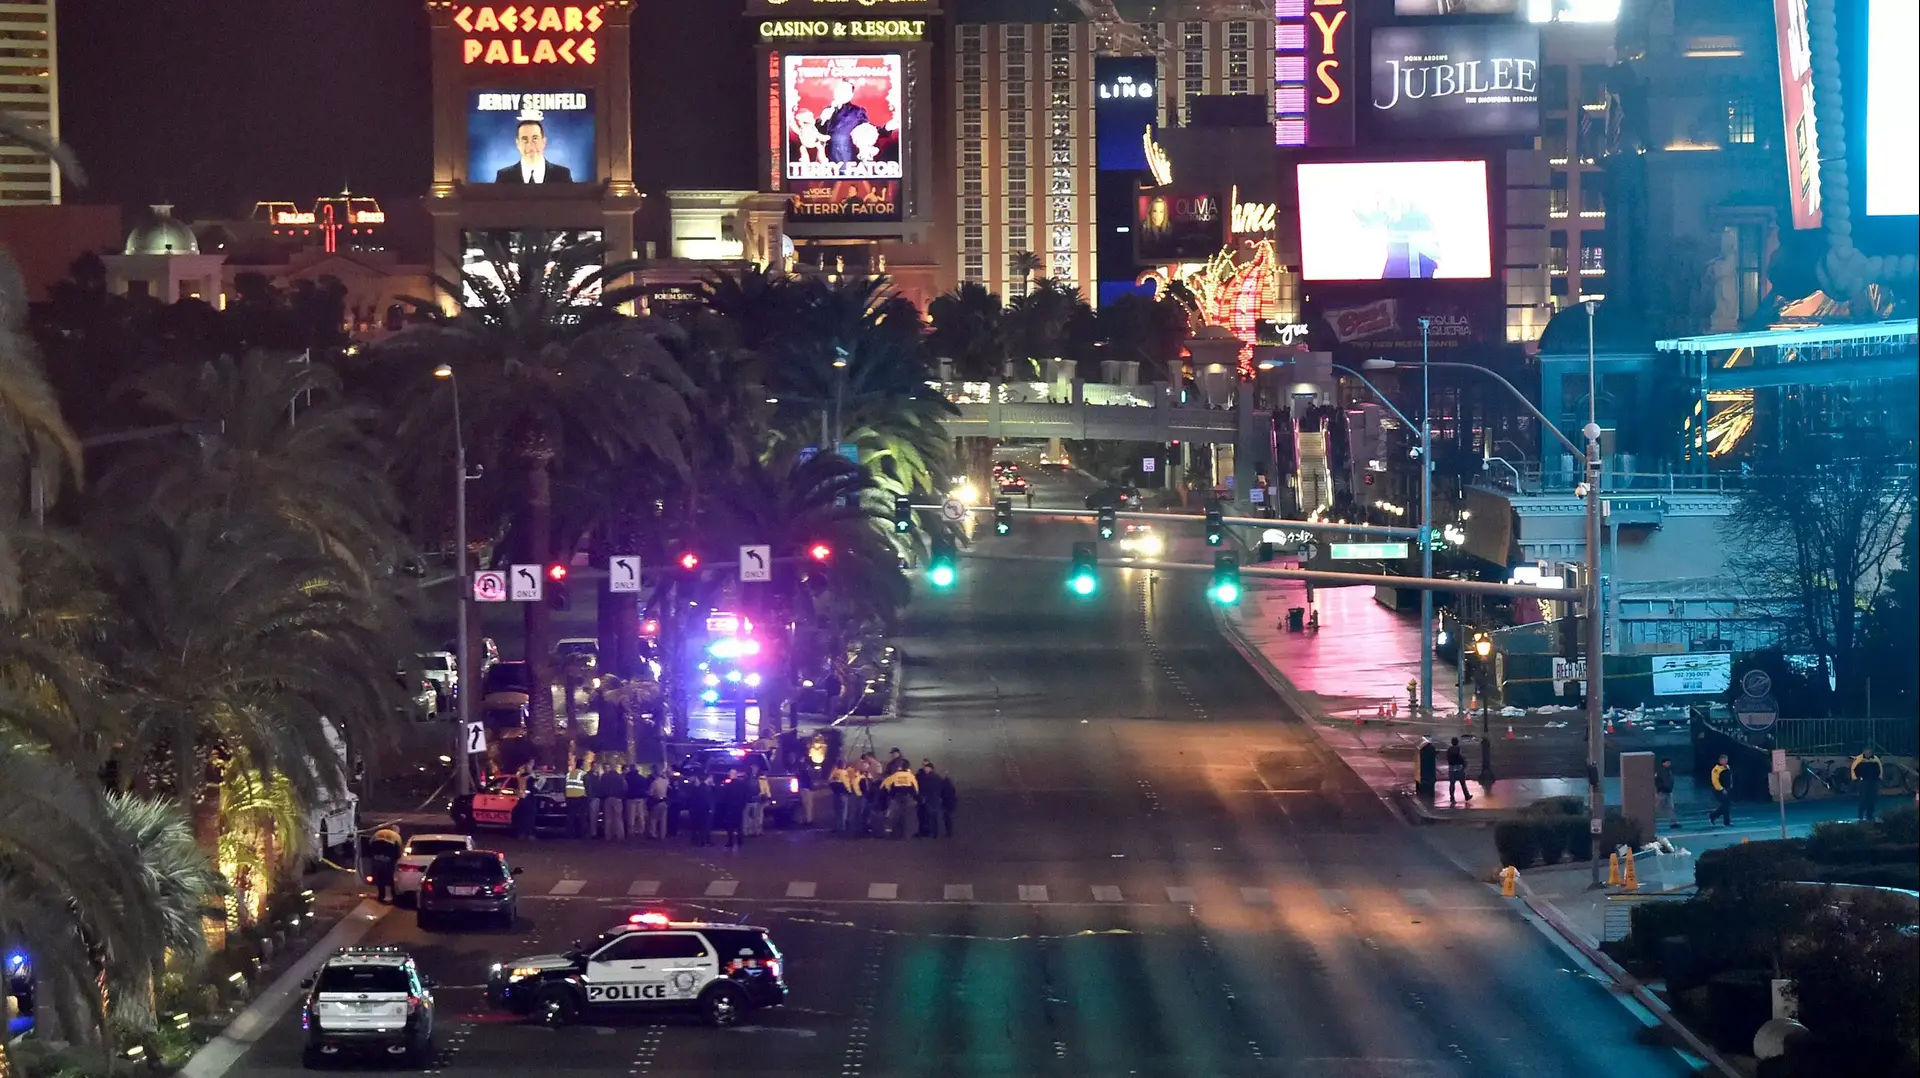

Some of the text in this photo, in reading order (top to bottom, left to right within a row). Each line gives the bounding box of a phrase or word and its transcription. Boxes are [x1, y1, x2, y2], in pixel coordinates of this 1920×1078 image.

[453, 4, 604, 33] CAESARS
[759, 20, 926, 37] CASINO & RESORT
[463, 37, 597, 65] PALACE
[1309, 0, 1348, 105] YS
[1100, 82, 1153, 99] LINQ
[1373, 57, 1538, 110] JUBILEE
[477, 93, 588, 111] JERRY SEINFELD
[804, 203, 895, 214] TERRY FATOR
[744, 570, 765, 579] ONLY
[516, 589, 537, 598] ONLY
[614, 581, 635, 590] ONLY
[589, 984, 666, 1000] POLICE
